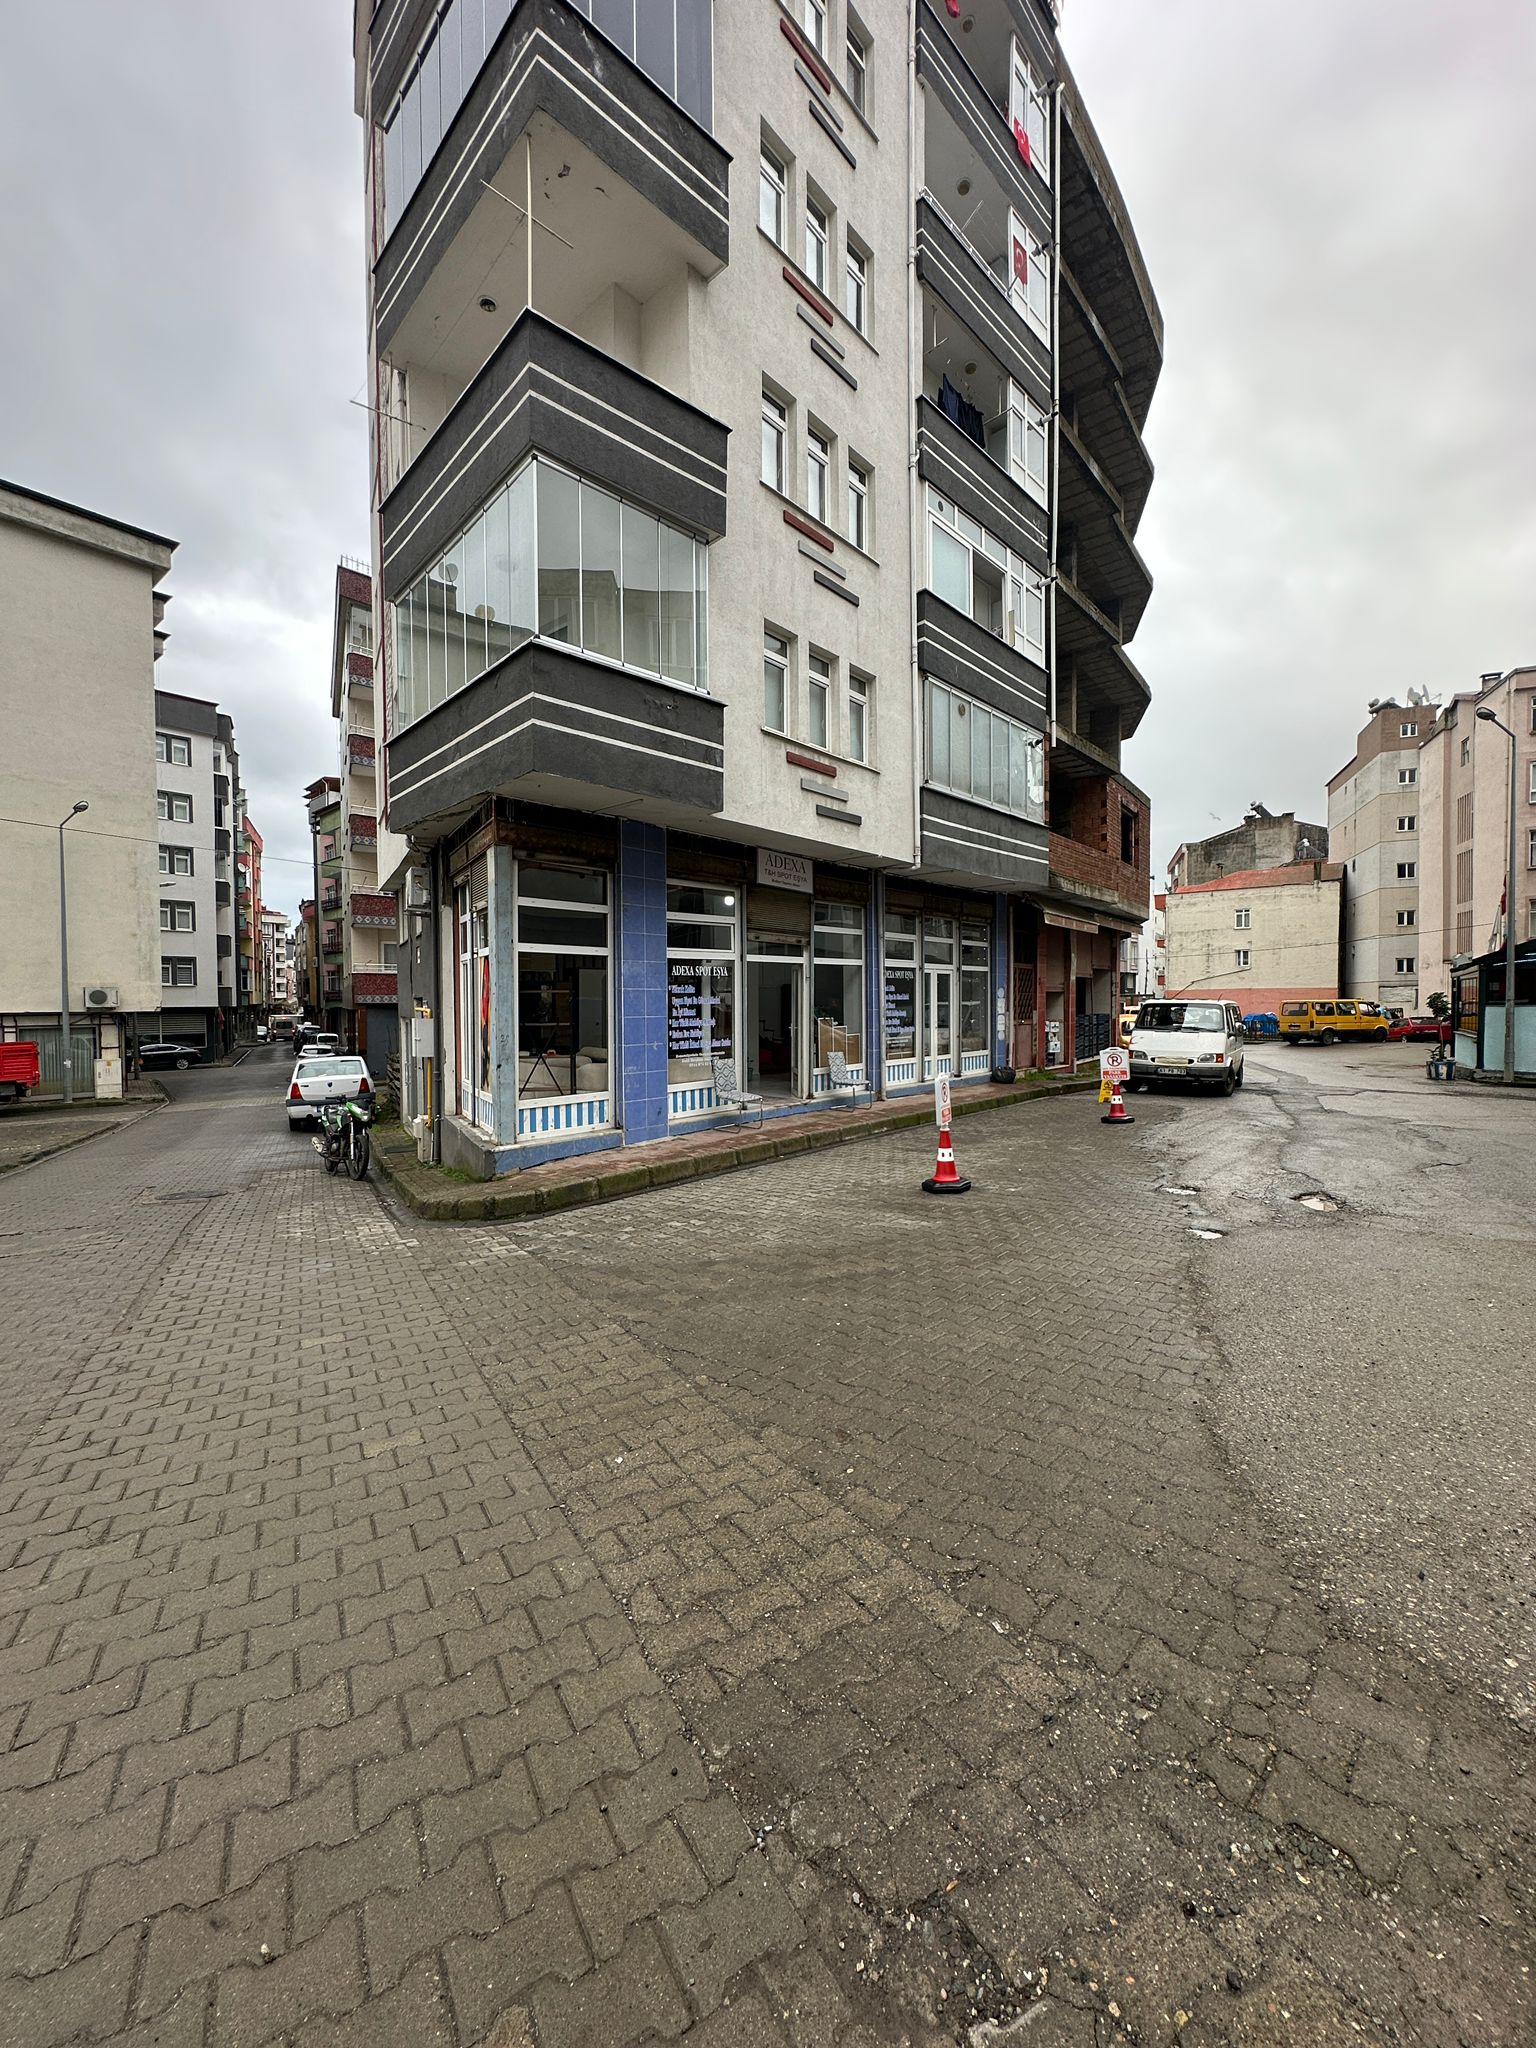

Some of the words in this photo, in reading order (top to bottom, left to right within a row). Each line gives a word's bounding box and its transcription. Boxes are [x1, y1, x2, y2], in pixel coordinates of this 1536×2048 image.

[765, 852, 806, 874] ADEXA
[777, 870, 792, 880] SPOT
[671, 965, 694, 976] ADEXA
[695, 965, 712, 976] SPOT
[713, 966, 729, 979] EŞYA
